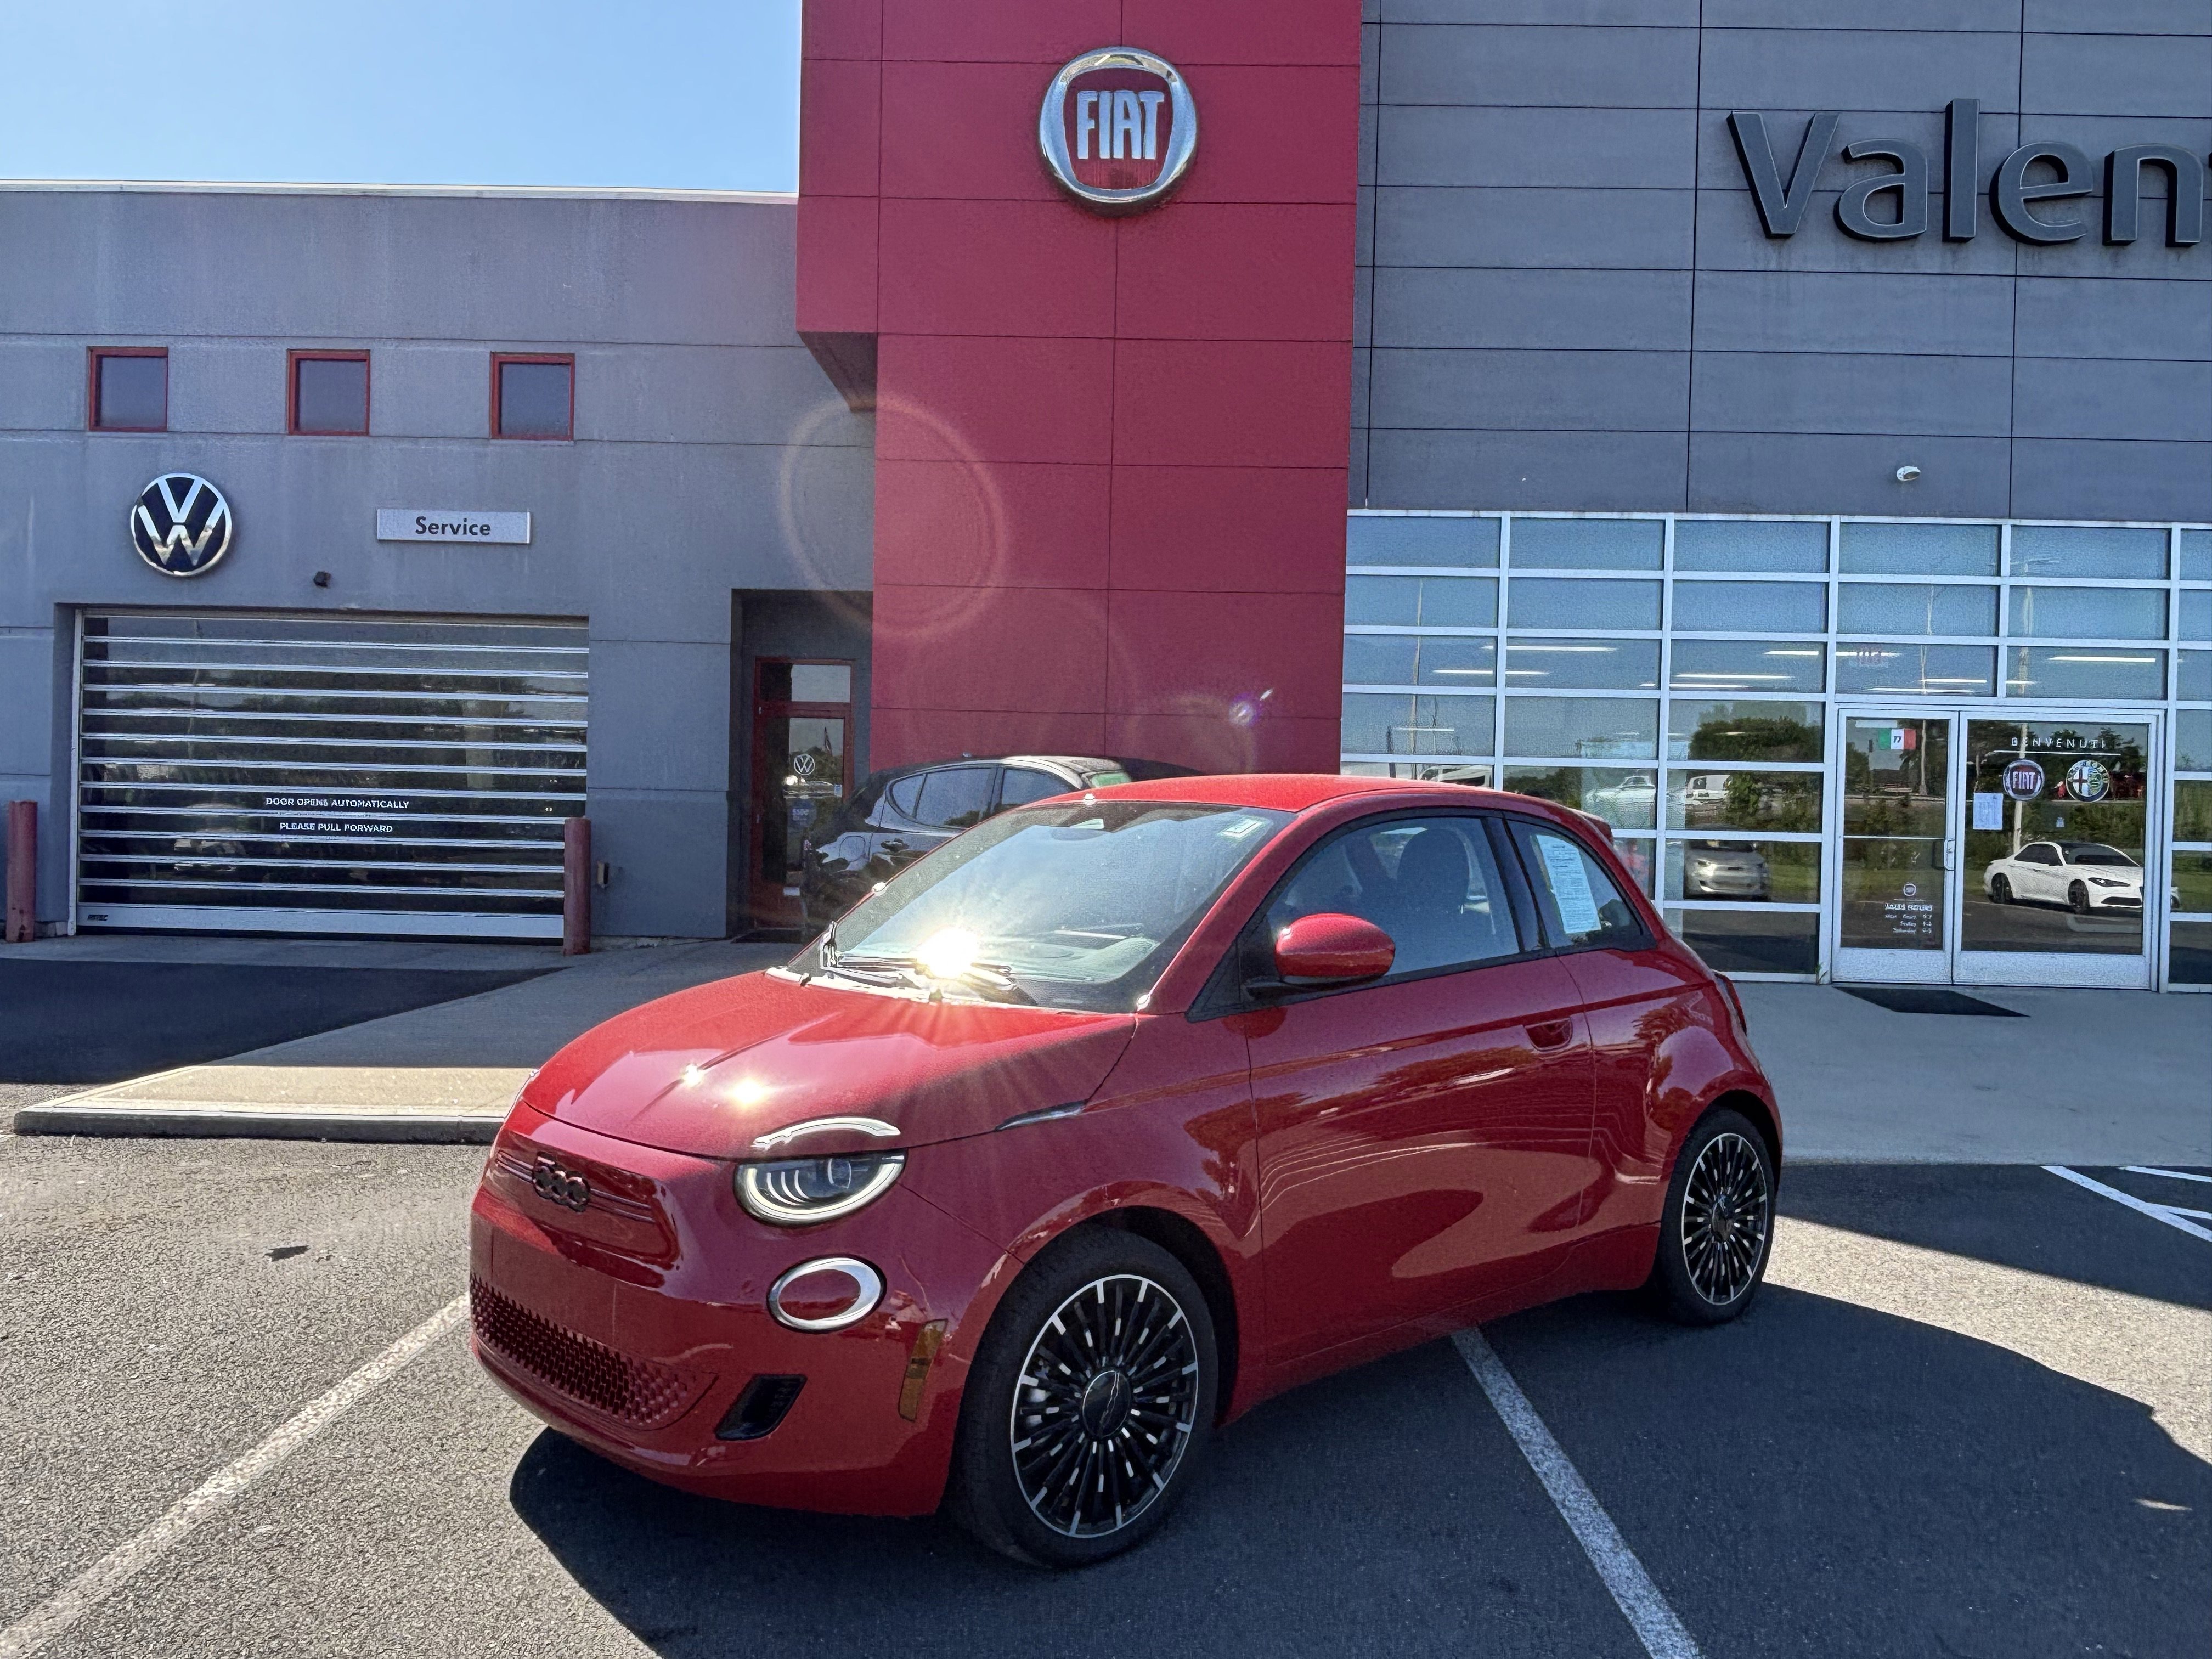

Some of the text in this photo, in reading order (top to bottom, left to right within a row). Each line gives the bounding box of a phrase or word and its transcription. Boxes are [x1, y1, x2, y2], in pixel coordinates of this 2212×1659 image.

[1077, 90, 1165, 159] FIAT
[1726, 99, 2212, 246] Valen
[415, 516, 491, 535] Service
[2011, 737, 2106, 749] BENVENUTI
[2012, 771, 2035, 790] FIAT
[266, 797, 295, 806] DOOR
[331, 799, 410, 809] AUTOMATICALLY
[280, 822, 393, 833] PLEASE PULL FORWARD
